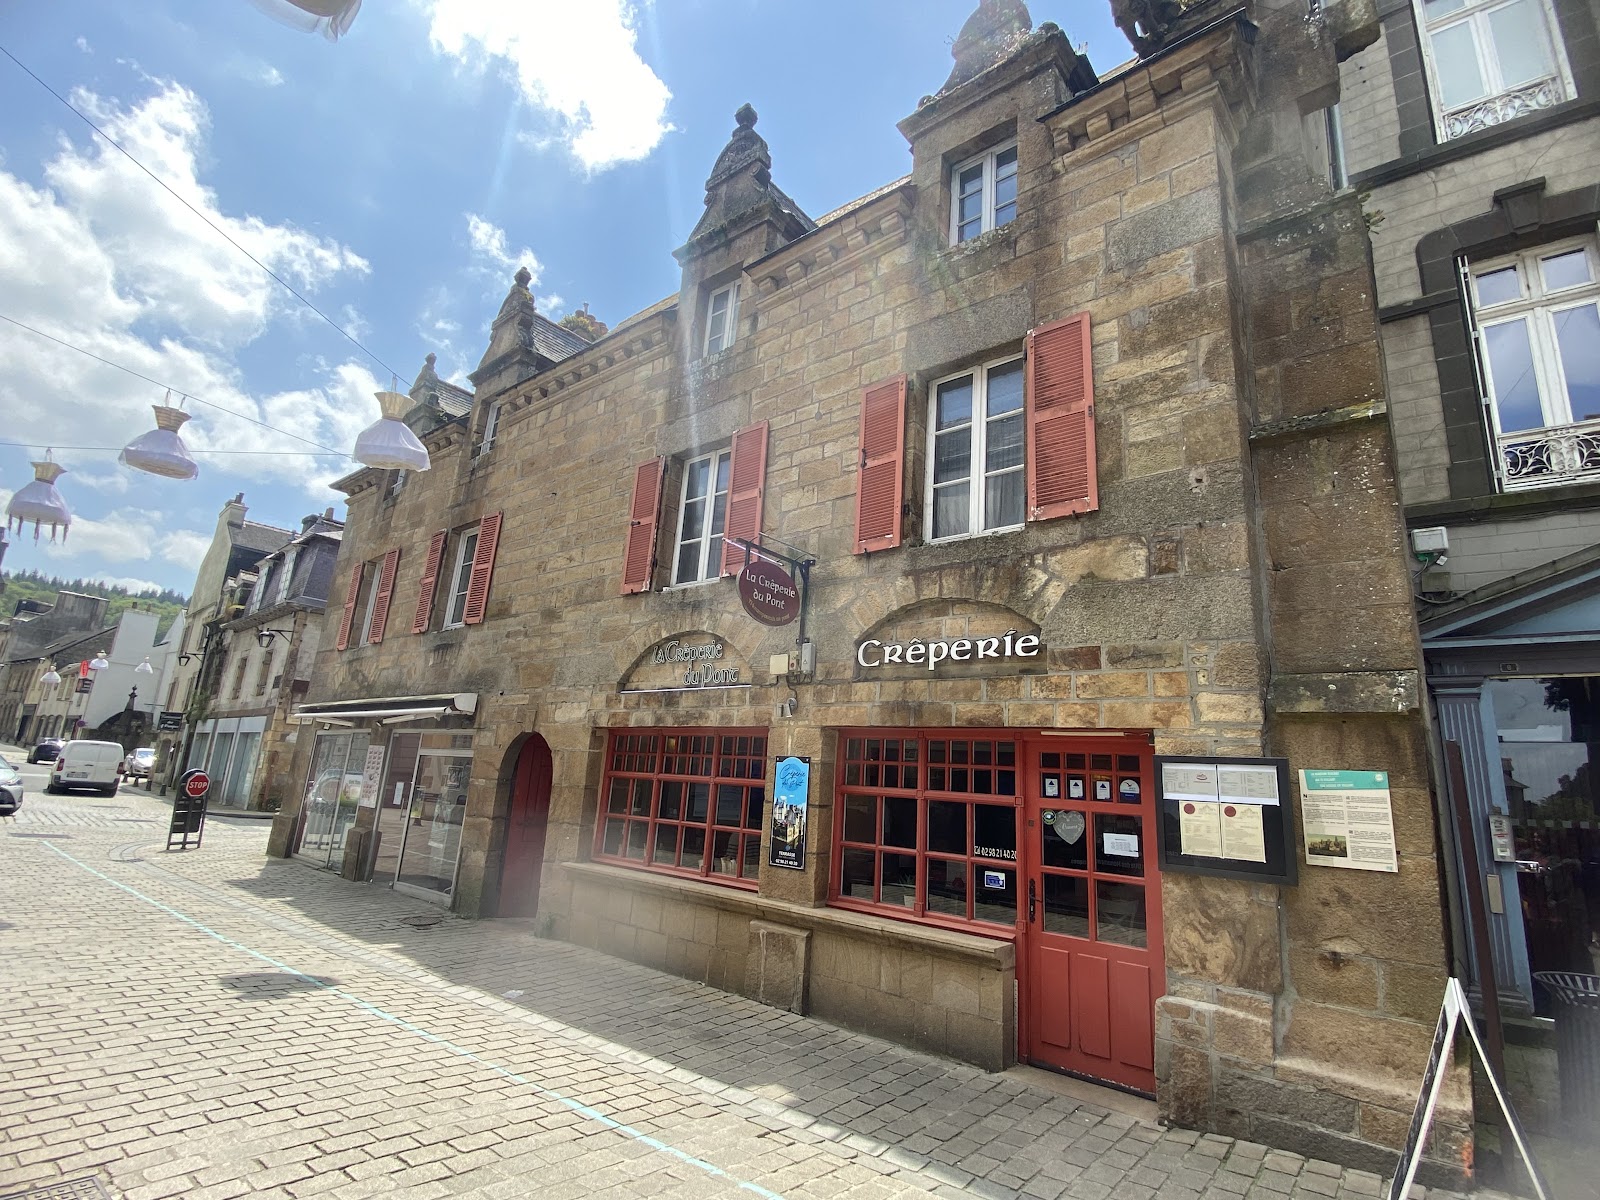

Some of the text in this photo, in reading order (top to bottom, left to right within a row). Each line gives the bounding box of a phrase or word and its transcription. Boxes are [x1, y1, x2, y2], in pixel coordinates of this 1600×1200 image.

[746, 569, 796, 598] La Crêperie
[753, 589, 764, 601] du
[766, 593, 785, 610] Pont
[665, 640, 723, 667] Crêperie
[857, 628, 1040, 671] Crêperie
[683, 663, 739, 688] du Pont
[189, 781, 208, 789] STOP
